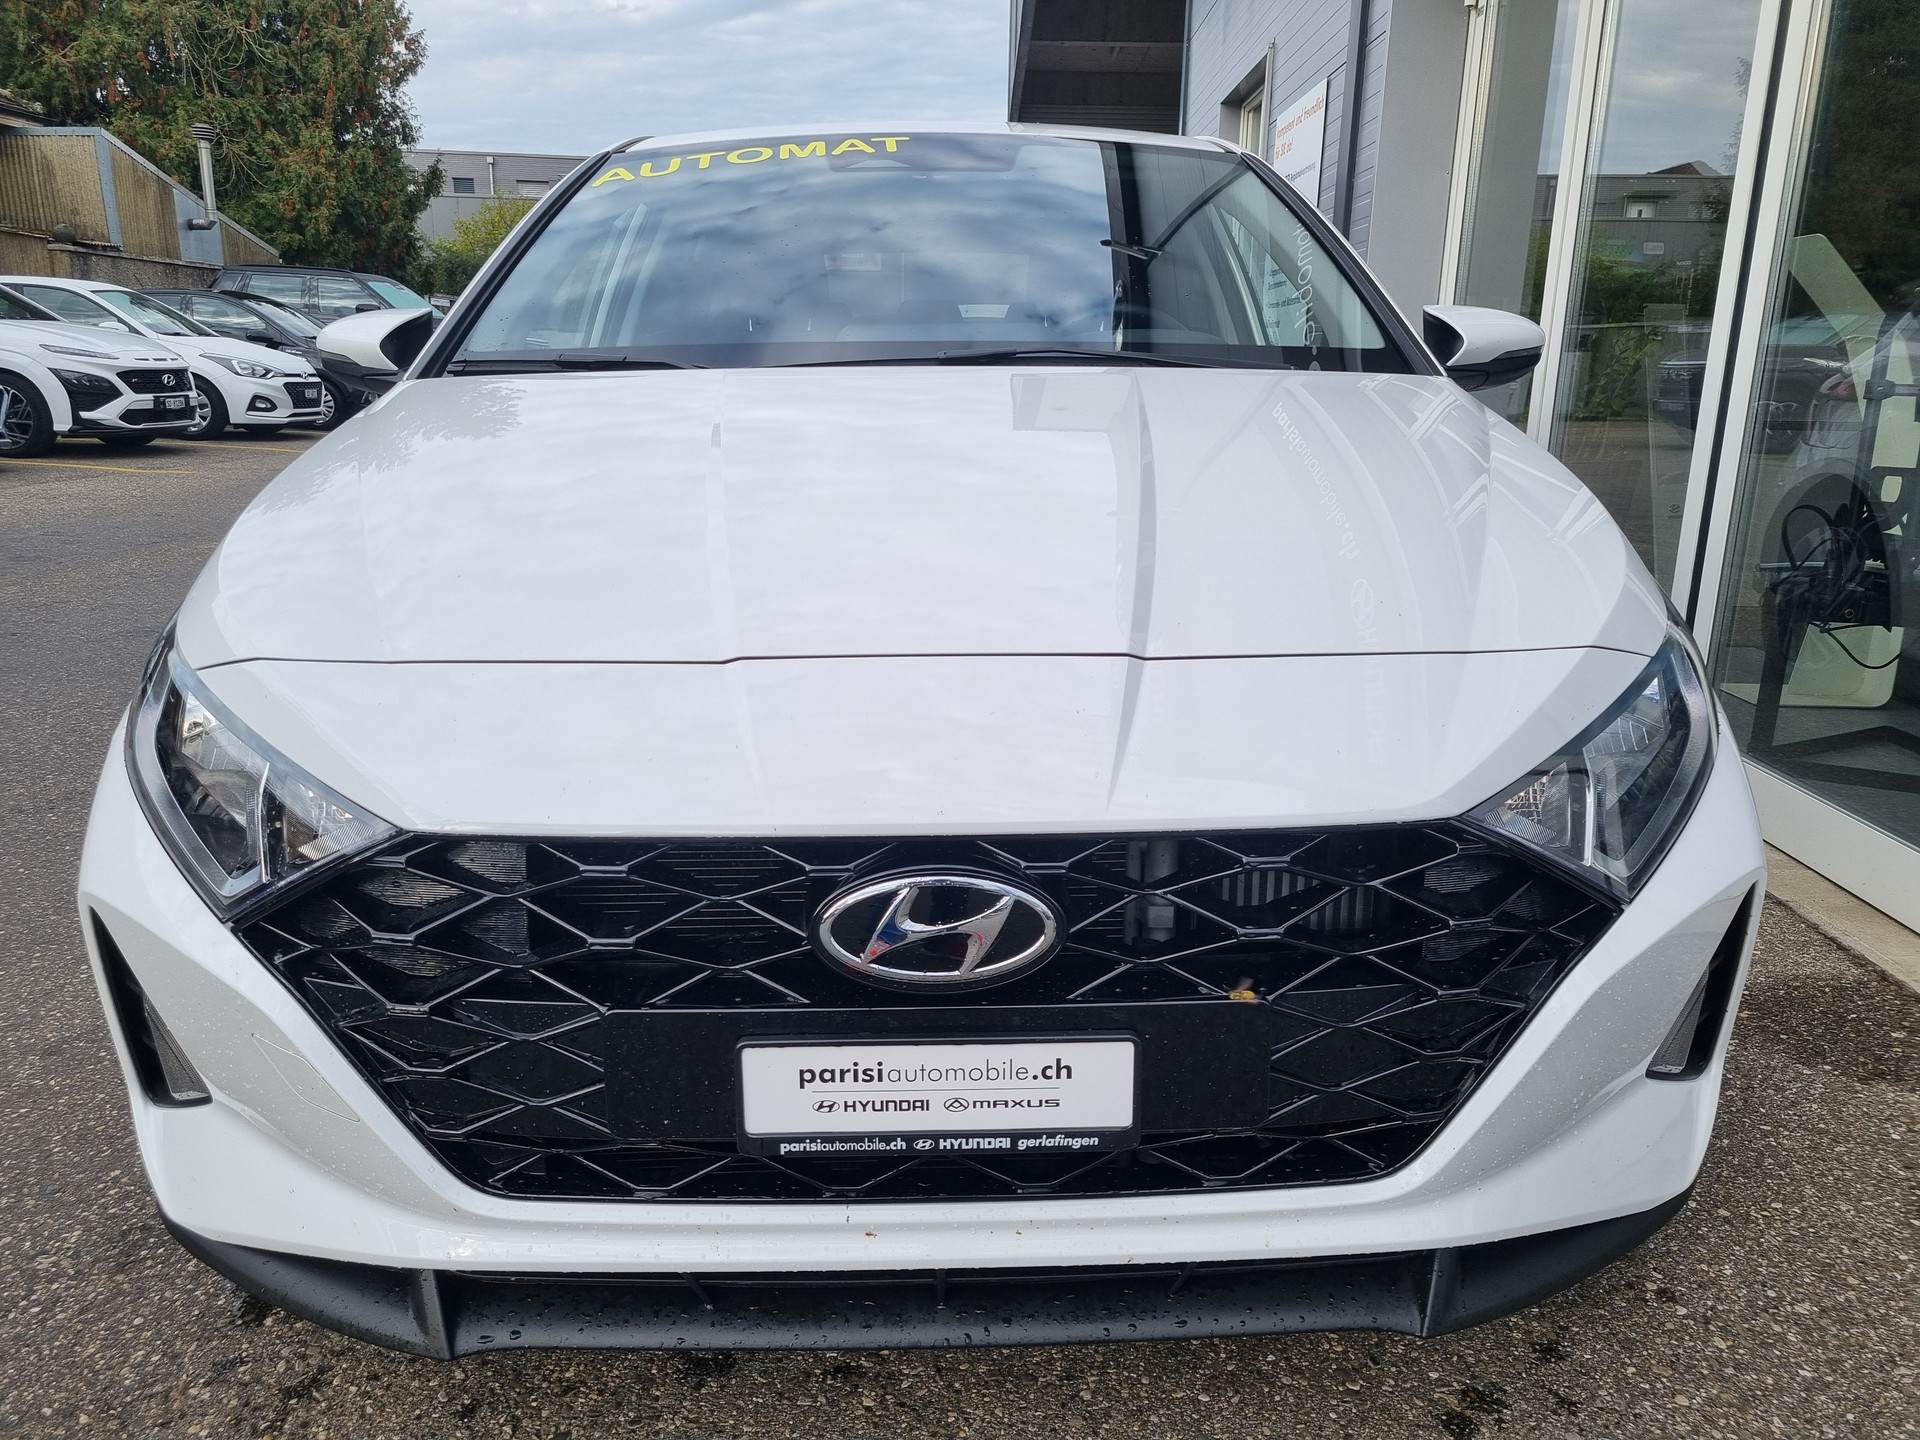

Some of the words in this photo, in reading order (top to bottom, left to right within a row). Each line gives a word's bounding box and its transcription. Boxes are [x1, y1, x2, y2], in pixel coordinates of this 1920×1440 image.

[591, 136, 911, 187] AUTOMAT
[799, 1058, 1073, 1089] parisiautomobile.ch
[843, 1099, 930, 1113] HYUNDAI
[780, 1137, 907, 1155] parisiautomobile.ch
[939, 1137, 1011, 1150] HYUNDAI
[1017, 1134, 1099, 1150] gerlafingen
